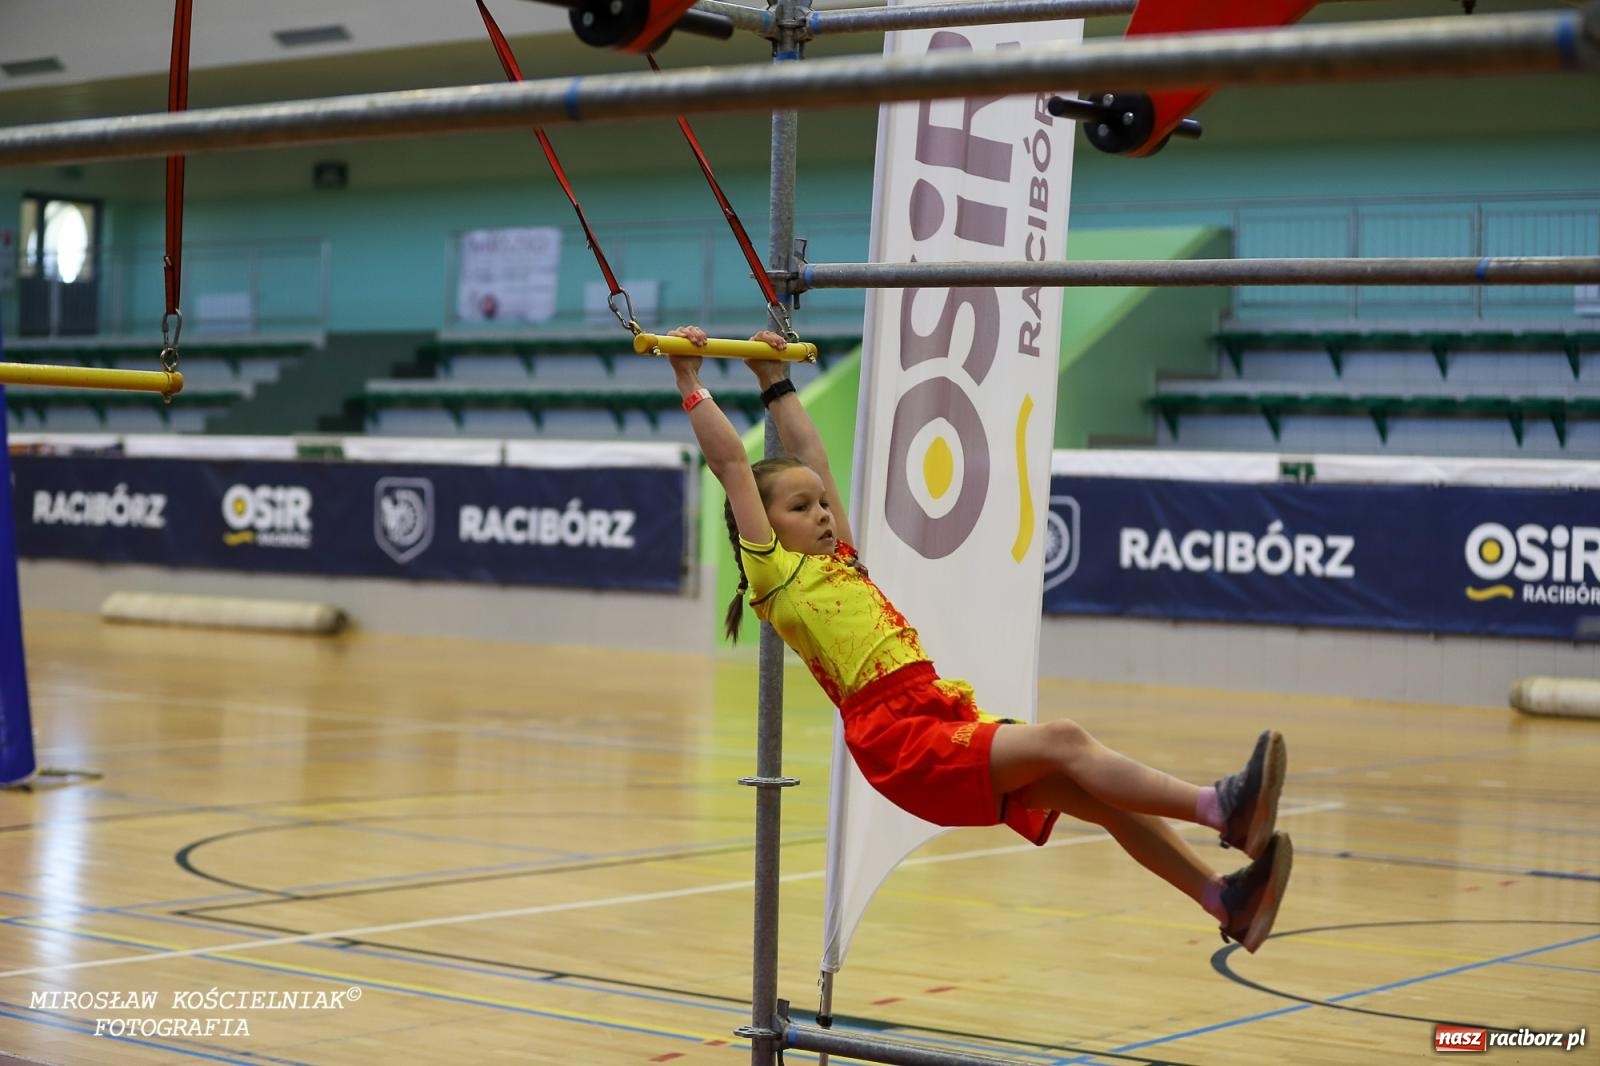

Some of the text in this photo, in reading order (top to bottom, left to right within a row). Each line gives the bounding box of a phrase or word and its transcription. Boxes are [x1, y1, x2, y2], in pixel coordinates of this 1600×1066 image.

[1018, 91, 1055, 357] RACIBÓR
[33, 482, 167, 528] RACIBÓRZ
[459, 498, 635, 548] RACIBÓRZ
[1119, 519, 1355, 578] RACIBÓRZ
